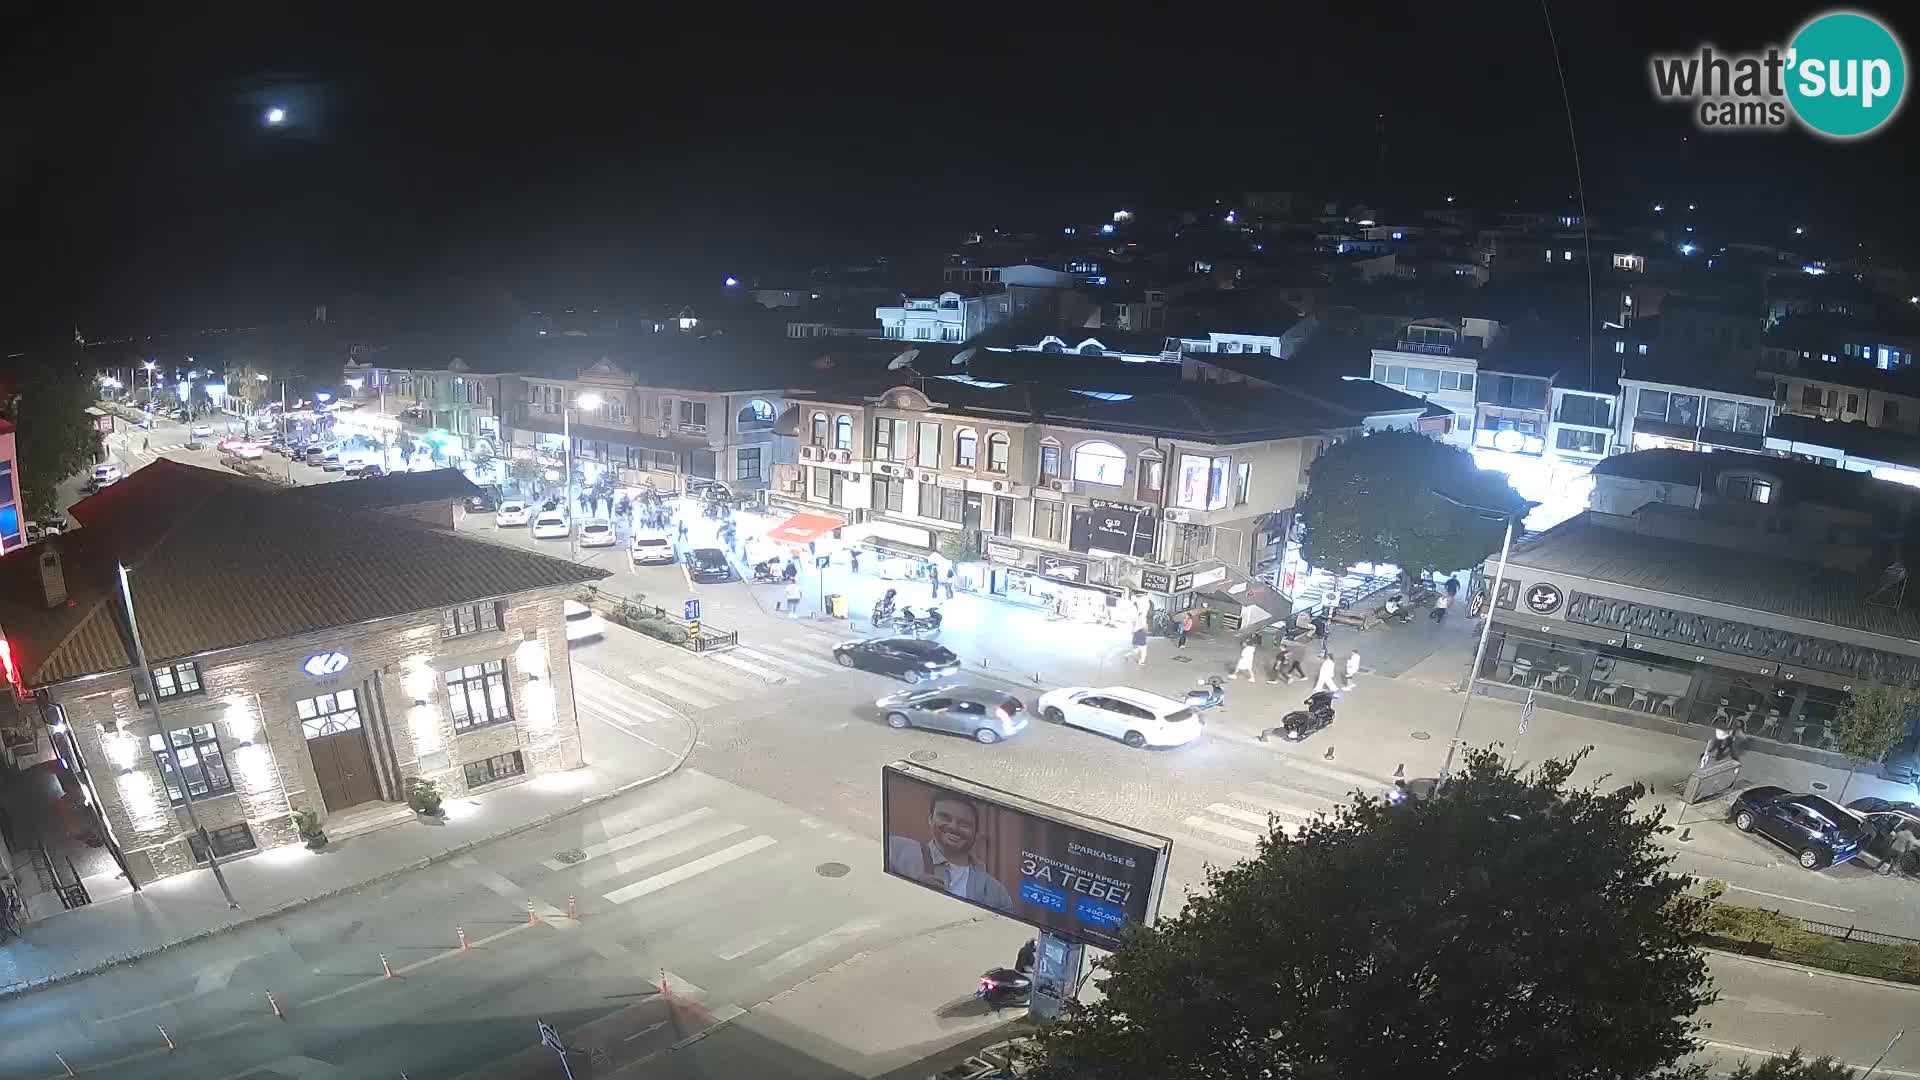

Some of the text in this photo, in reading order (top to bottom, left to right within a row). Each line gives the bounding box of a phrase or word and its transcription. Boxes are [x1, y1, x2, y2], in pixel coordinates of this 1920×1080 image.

[1068, 842, 1125, 865] SPARKASSE
[1020, 859, 1052, 883] ЗА
[1059, 870, 1131, 906] ТЕБЕ!
